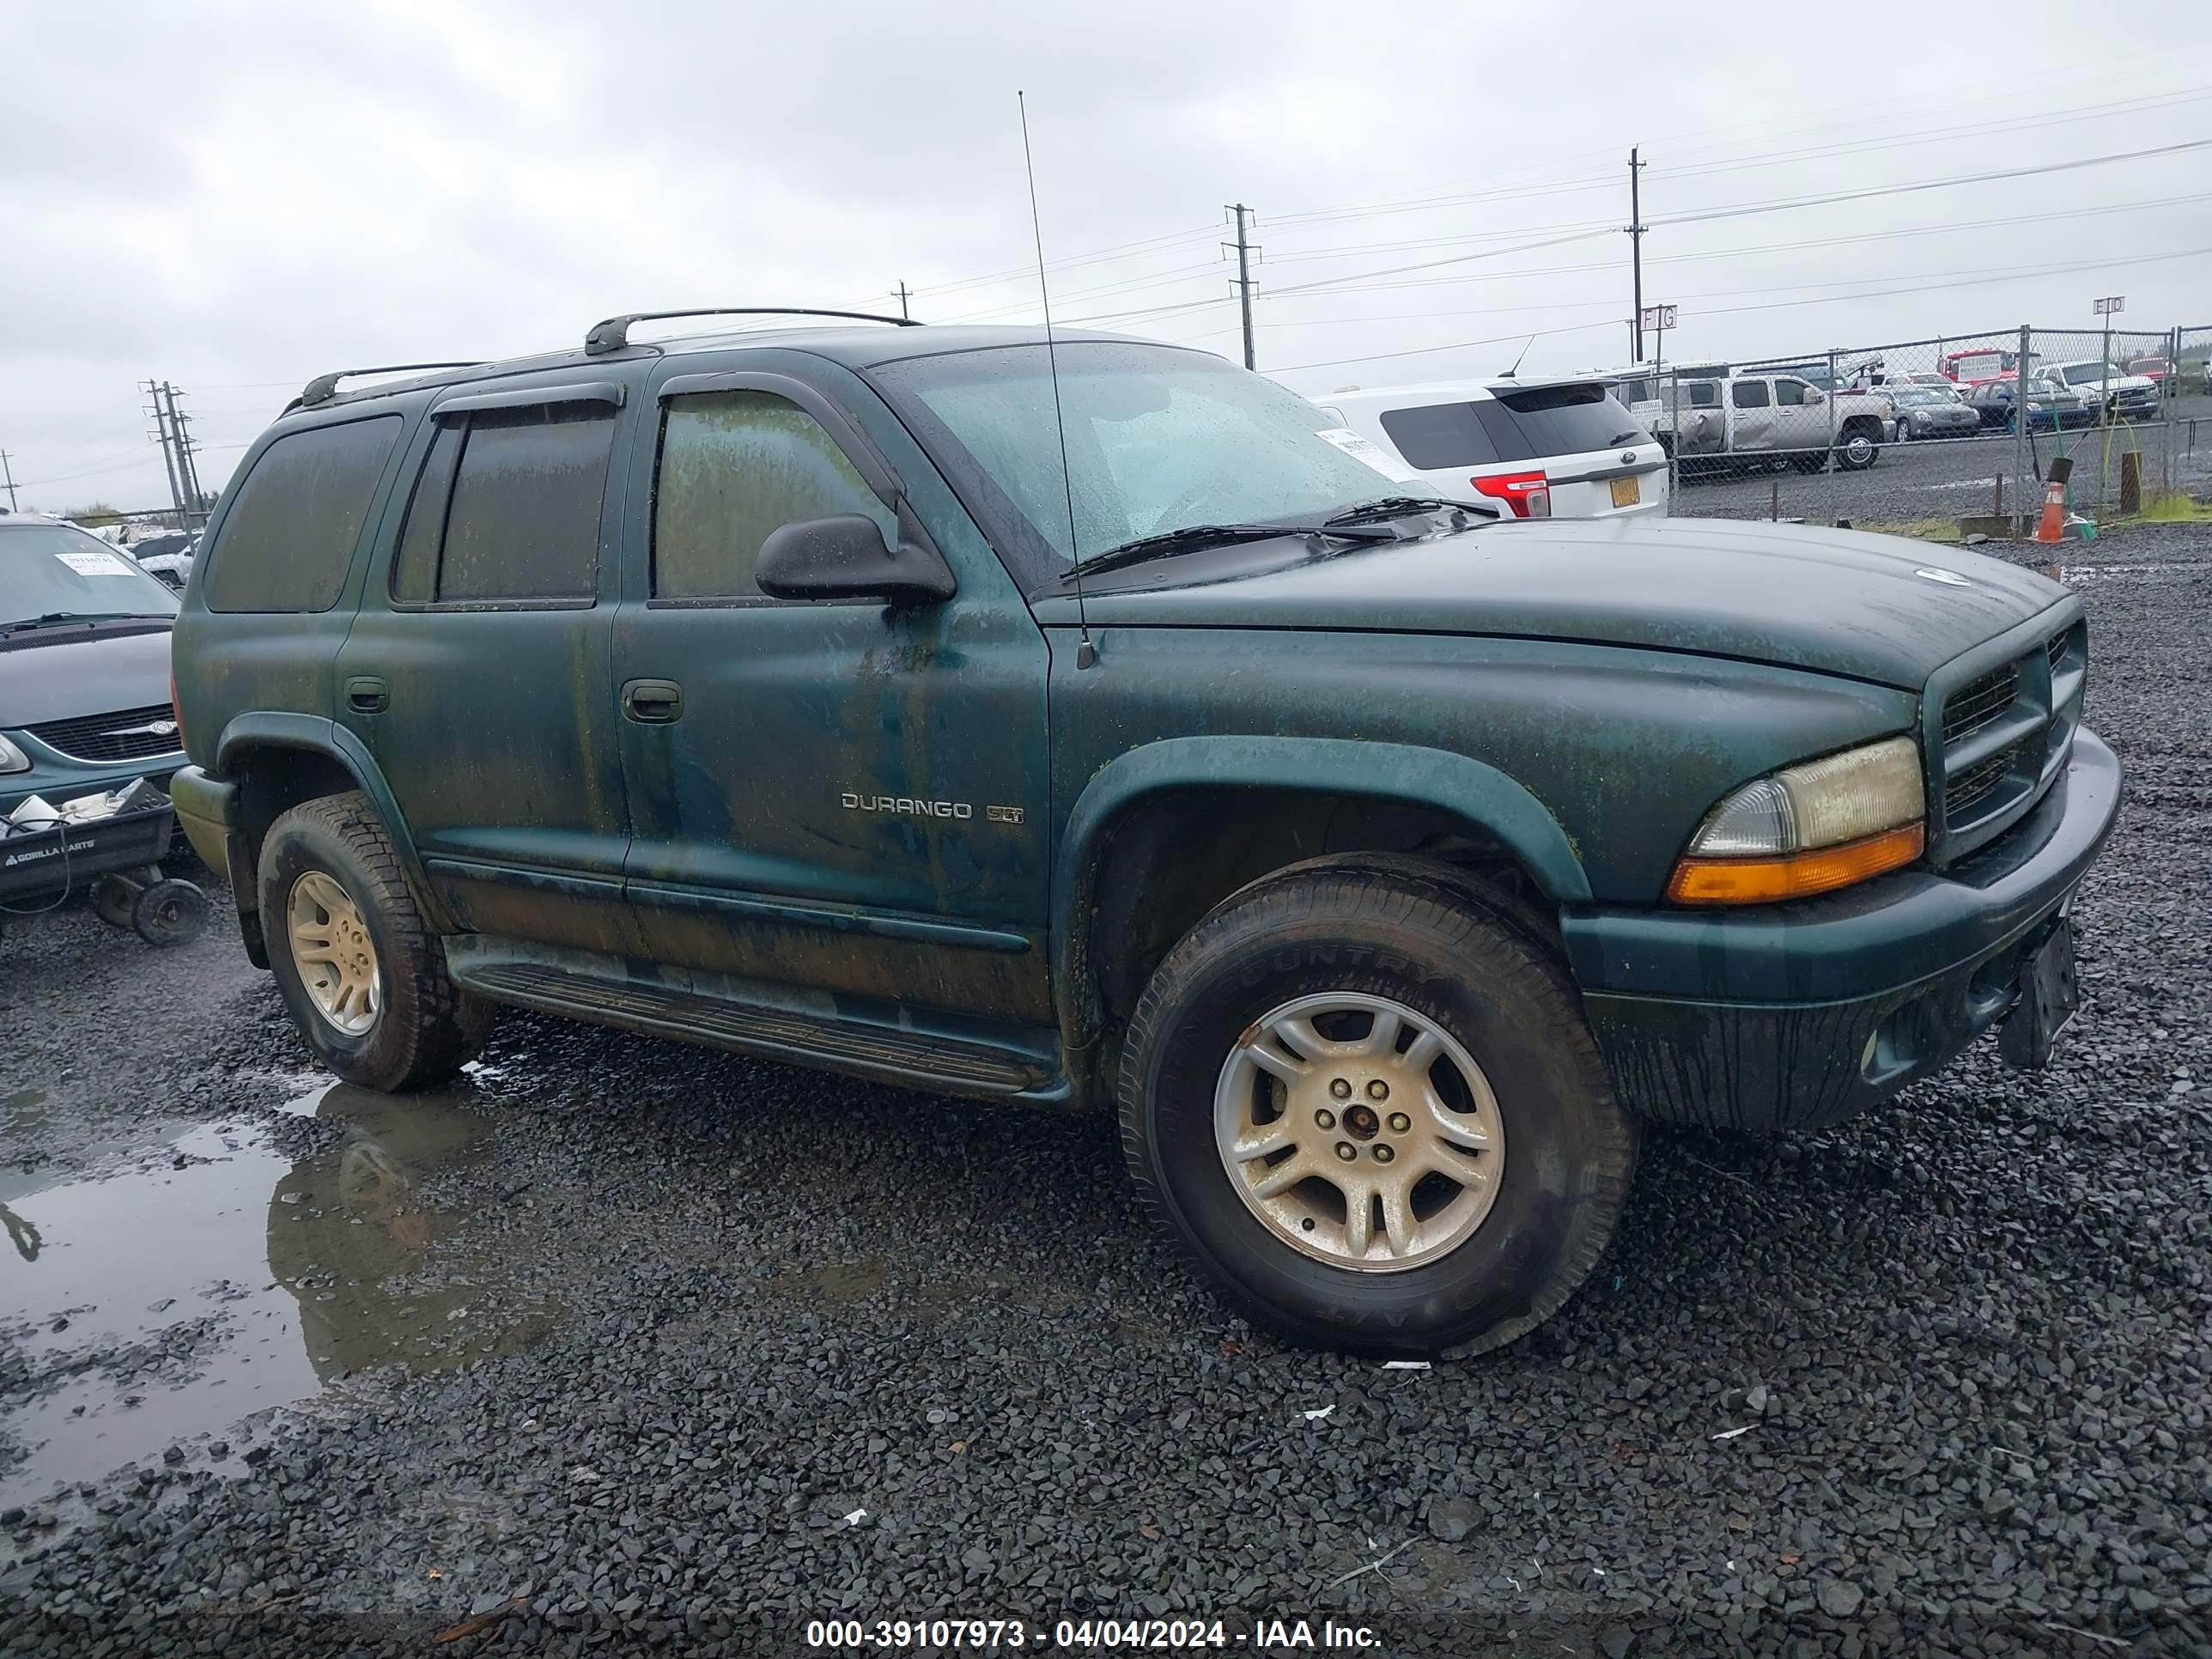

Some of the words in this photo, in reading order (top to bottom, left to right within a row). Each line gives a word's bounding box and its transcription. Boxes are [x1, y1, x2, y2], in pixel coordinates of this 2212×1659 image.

[2096, 299, 2103, 313] E
[2114, 297, 2122, 311] D
[1644, 308, 1652, 330] F
[1663, 307, 1674, 327] G
[1960, 356, 1999, 368] NATIONAL
[841, 793, 973, 820] DURANGO
[986, 805, 1024, 824] SLT
[16, 847, 60, 863] GORILLA
